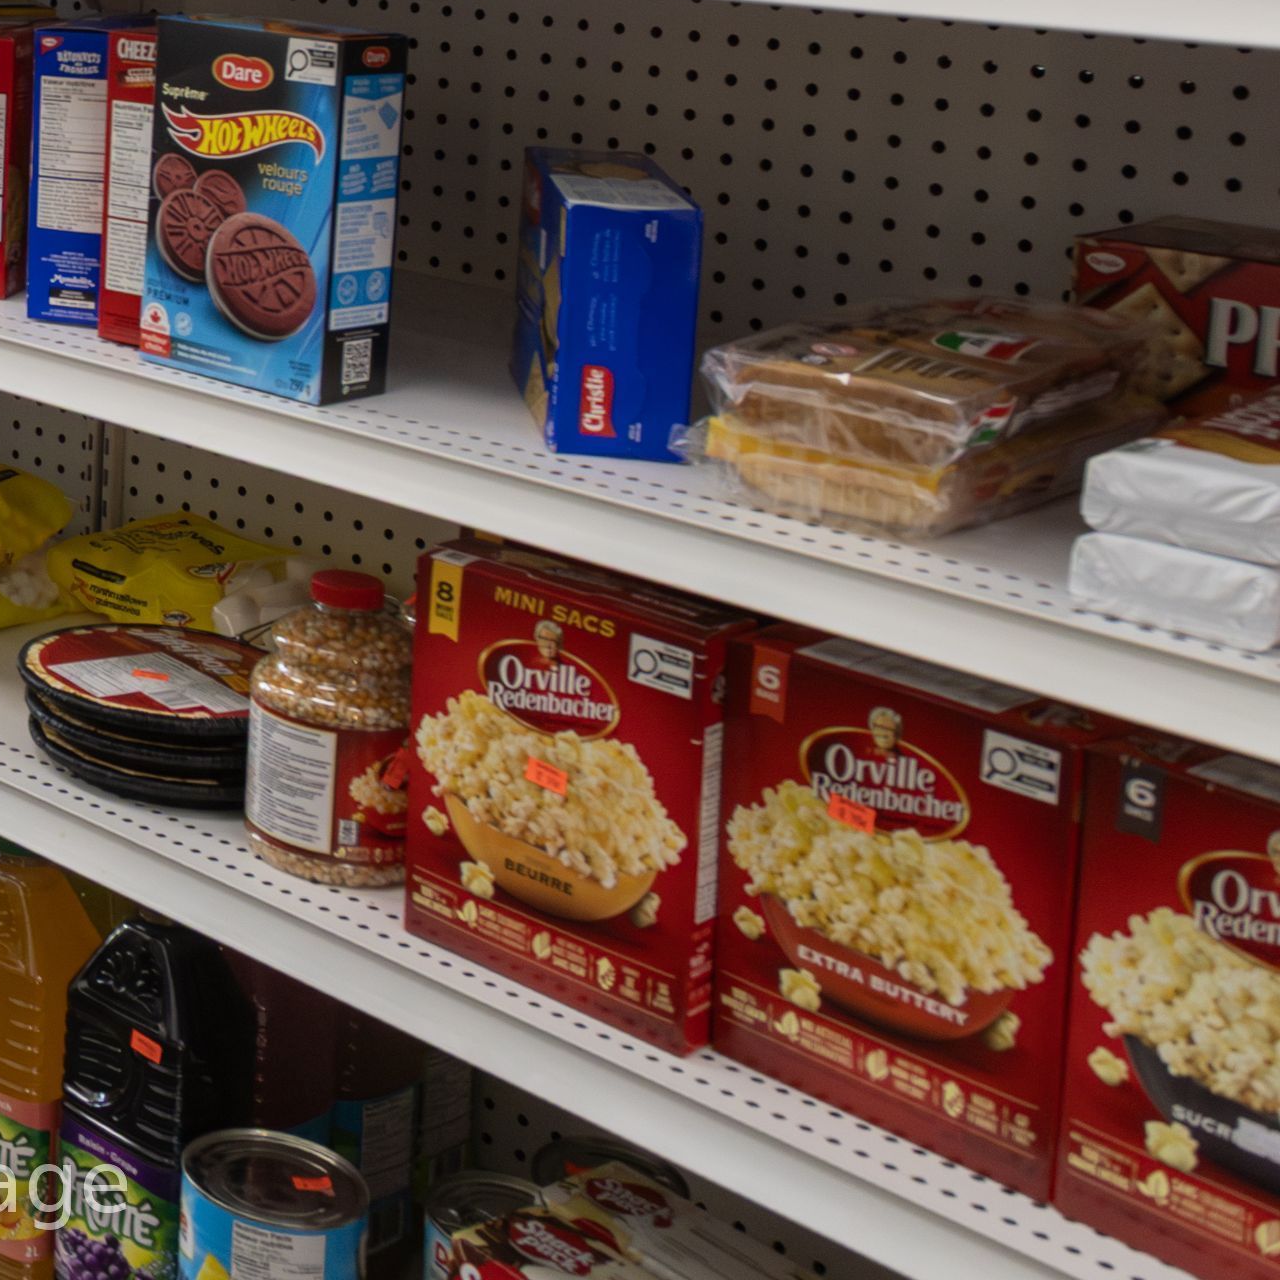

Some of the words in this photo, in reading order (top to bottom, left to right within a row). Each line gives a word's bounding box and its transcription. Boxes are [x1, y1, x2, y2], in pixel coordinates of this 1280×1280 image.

[222, 61, 262, 83] Dare
[162, 82, 208, 102] Suprême
[257, 162, 309, 180] velours
[262, 177, 303, 197] rouge
[147, 286, 189, 306] PREMIUM
[581, 368, 608, 436] Christie
[435, 579, 455, 606] 8
[495, 585, 548, 613] MINI
[552, 601, 617, 639] SACS
[497, 655, 592, 697] Orville
[757, 664, 780, 691] 6
[824, 743, 935, 792] Orville
[1126, 778, 1156, 808] 6
[504, 856, 574, 896] BEURRE
[797, 943, 864, 985] EXTRA
[869, 973, 970, 1027] BUTTERY
[513, 1220, 595, 1264] Snack
